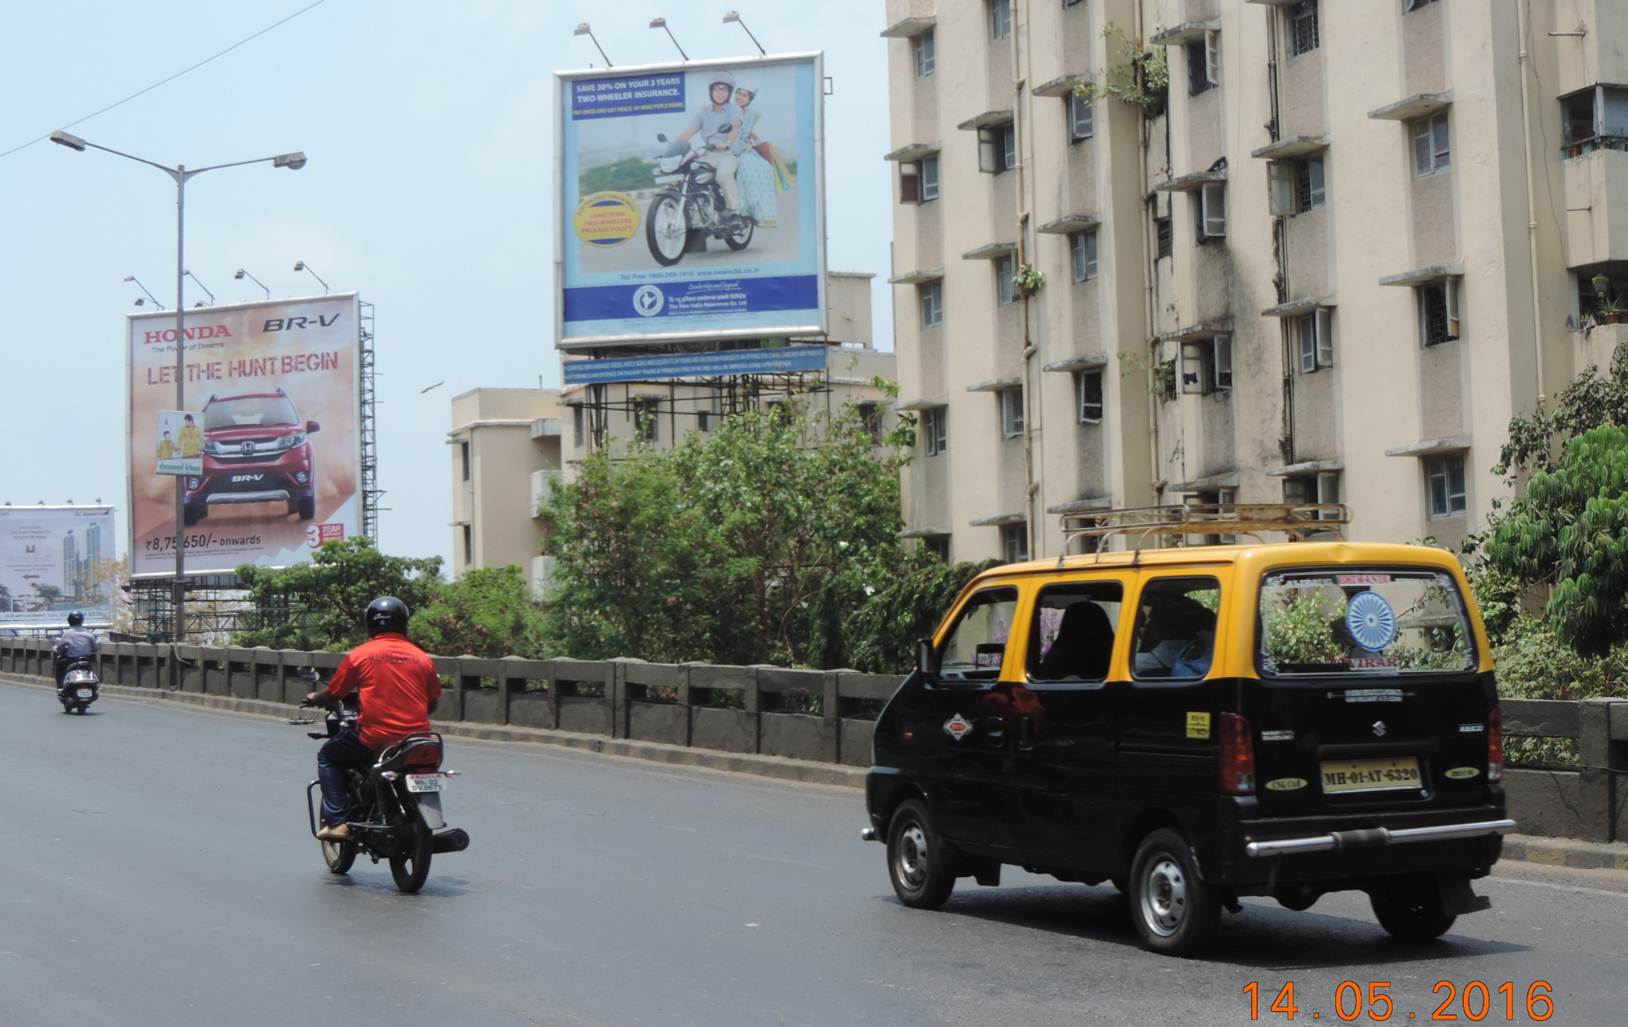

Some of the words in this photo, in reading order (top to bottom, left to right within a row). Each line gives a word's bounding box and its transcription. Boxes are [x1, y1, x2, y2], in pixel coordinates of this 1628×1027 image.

[576, 84, 596, 93] SAVE
[597, 83, 613, 91] 30%
[614, 82, 626, 90] ON
[628, 80, 650, 88] YOUR
[656, 77, 681, 86] YEARS
[577, 92, 633, 103] TWO-WHEELER
[262, 312, 341, 333] BR-V
[144, 325, 232, 344] HONDA
[198, 342, 225, 350] Dreams
[186, 361, 223, 383] THE
[228, 356, 278, 379] HUNT
[281, 351, 339, 373] BEGIN
[232, 474, 264, 483] BR-V
[219, 534, 262, 546] onwards
[307, 525, 321, 547] 3
